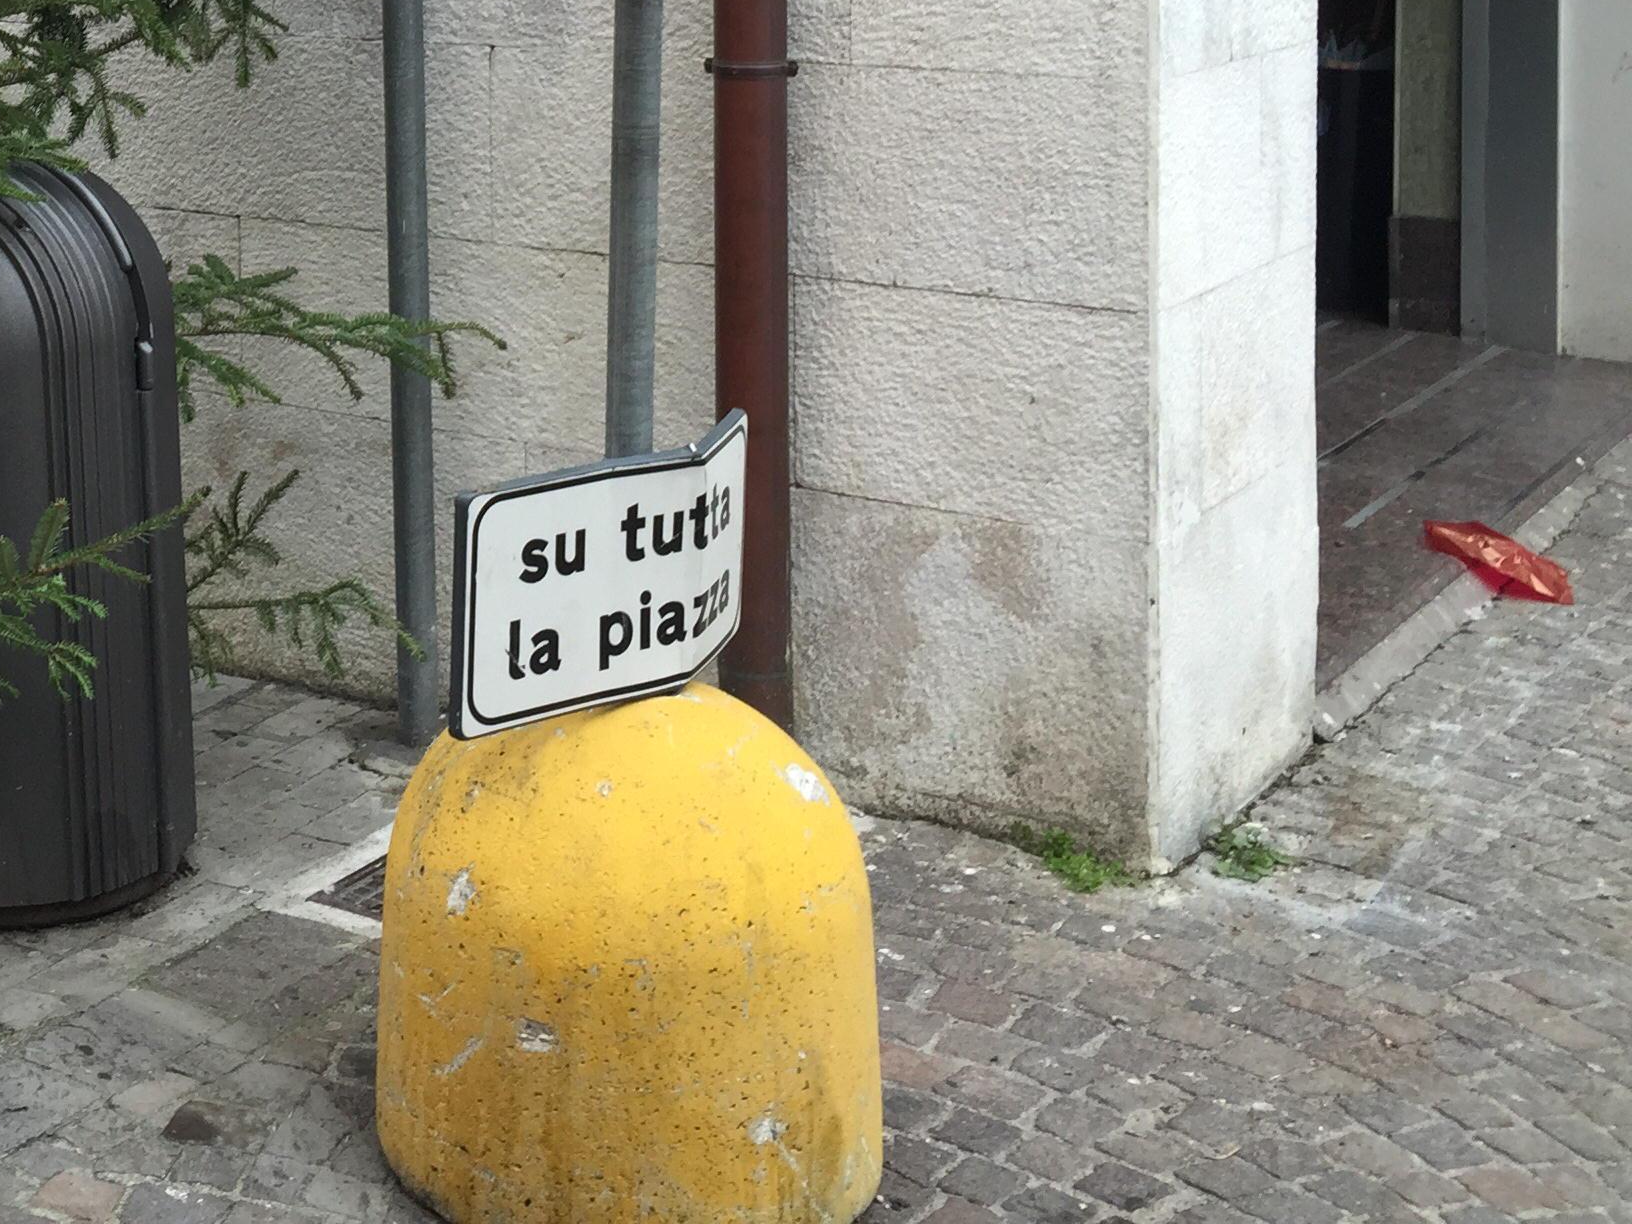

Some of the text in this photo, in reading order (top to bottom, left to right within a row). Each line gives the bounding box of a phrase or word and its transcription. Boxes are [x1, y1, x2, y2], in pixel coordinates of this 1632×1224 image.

[519, 484, 730, 583] su tutta
[508, 569, 730, 680] la piazza
